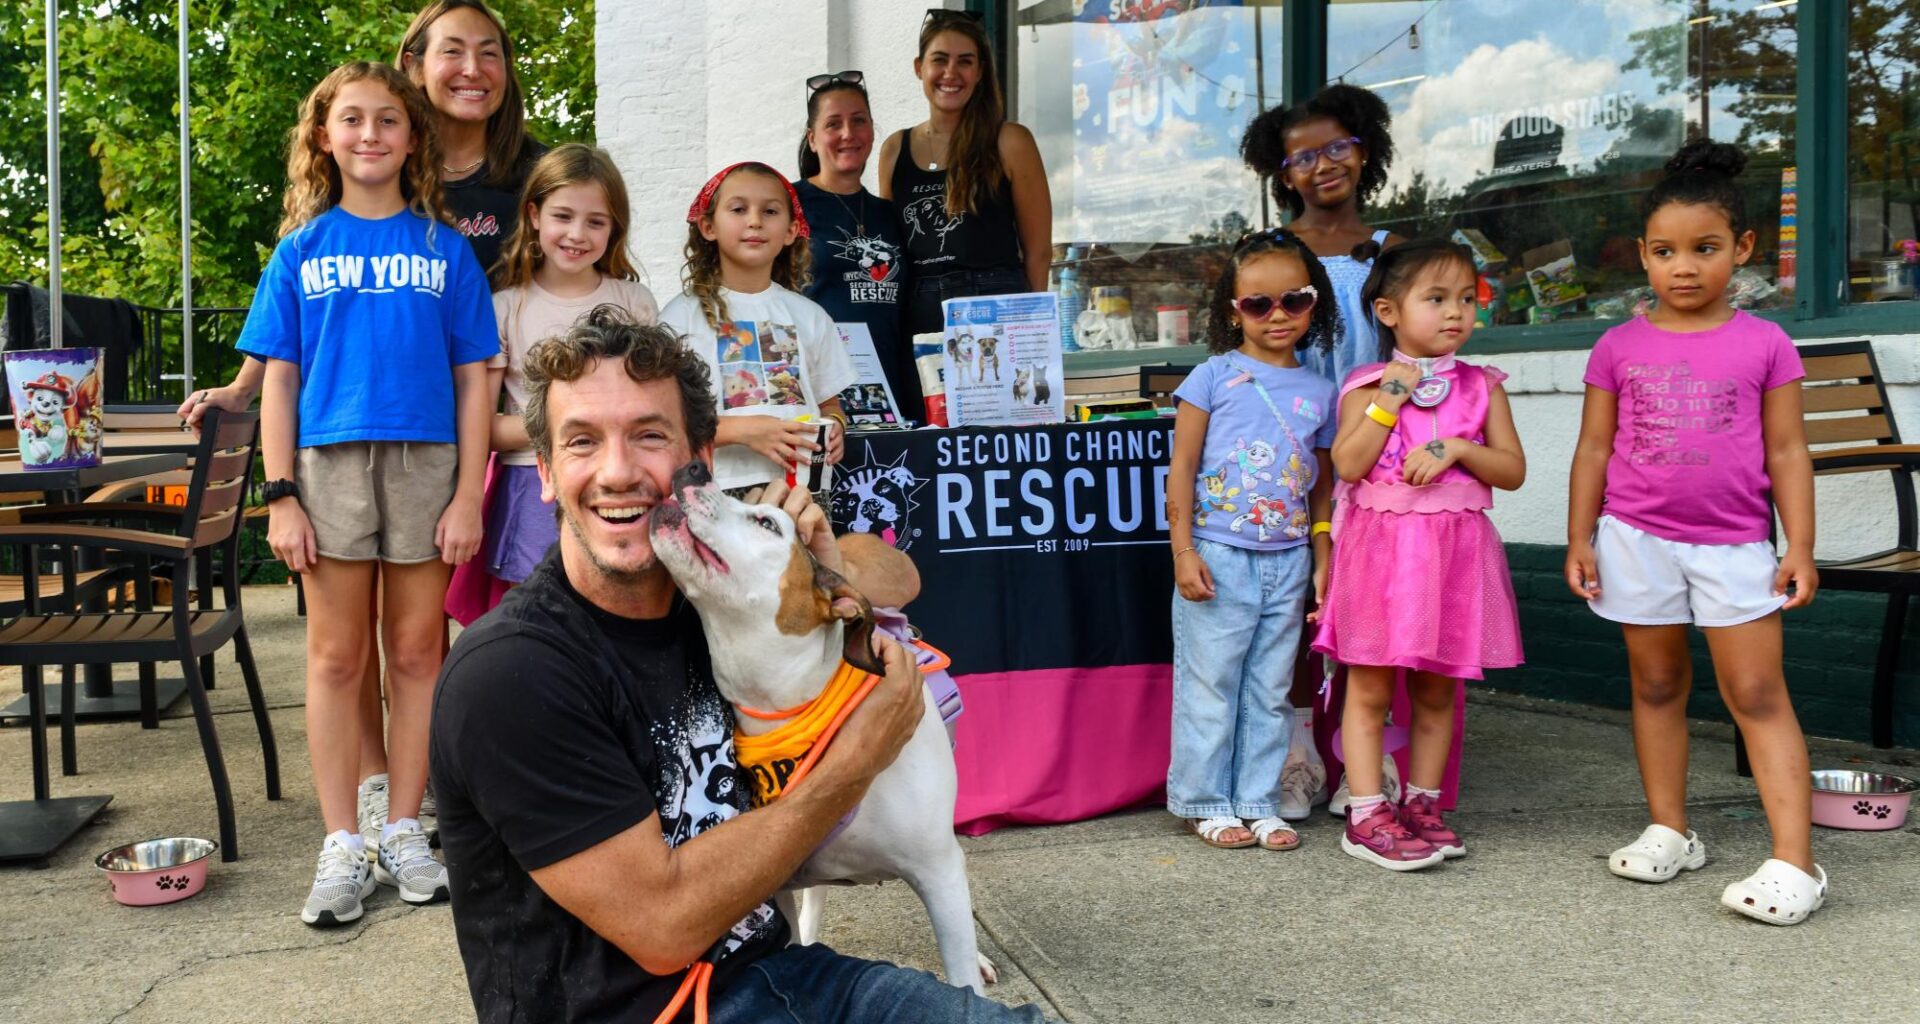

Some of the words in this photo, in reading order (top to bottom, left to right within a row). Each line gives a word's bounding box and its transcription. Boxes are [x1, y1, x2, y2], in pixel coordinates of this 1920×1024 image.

[1107, 73, 1197, 134] FUN
[1469, 111, 1506, 145] THE
[1563, 89, 1635, 130] STARS
[912, 183, 945, 193] RESCU
[455, 211, 500, 238] gia
[300, 254, 365, 295] NEW
[370, 253, 448, 294] YORK
[849, 281, 876, 289] SECOND
[850, 288, 898, 301] RESCUE
[936, 432, 1051, 467] SECOND
[936, 466, 1170, 540] RESCUE
[1037, 540, 1057, 552] EST
[1064, 539, 1090, 552] 2009
